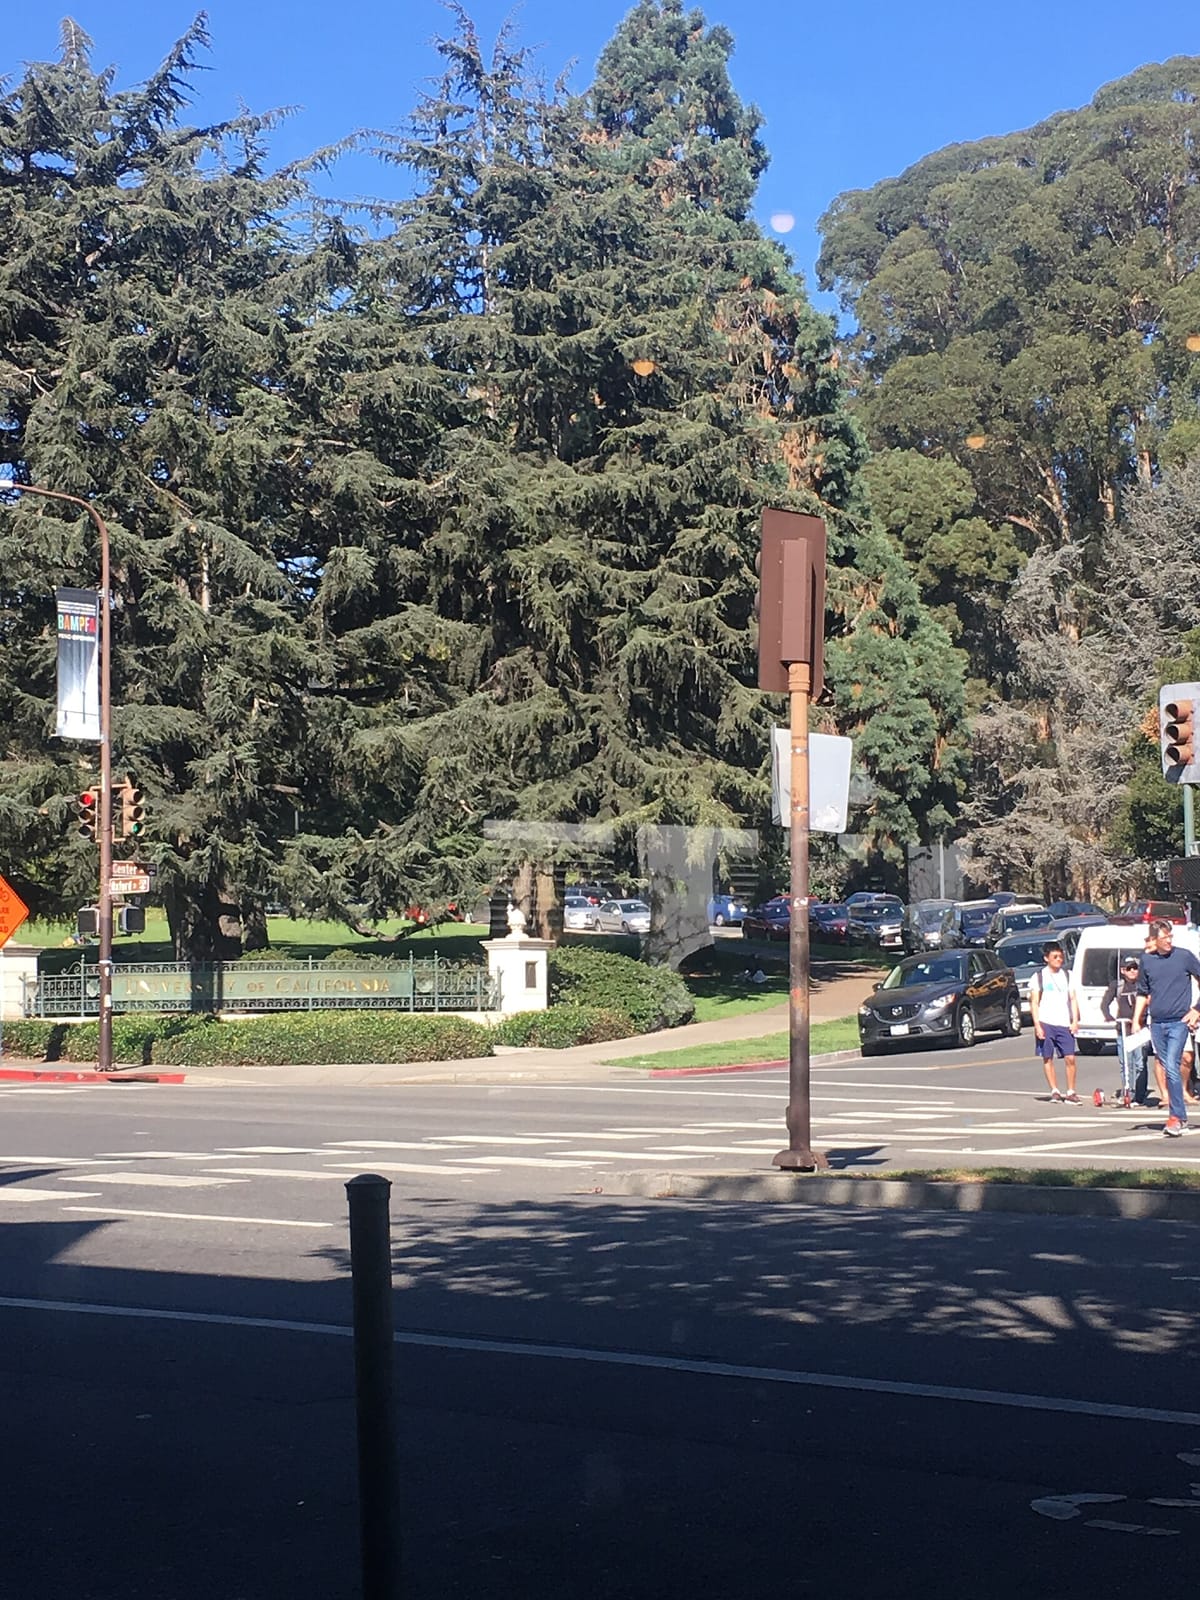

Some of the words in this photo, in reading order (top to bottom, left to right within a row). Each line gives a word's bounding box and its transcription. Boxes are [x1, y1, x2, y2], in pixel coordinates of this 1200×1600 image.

[57, 613, 97, 633] BAMPFA
[112, 863, 138, 876] Center
[125, 978, 236, 996] UNIVERY
[275, 976, 391, 993] CALIFORNIA
